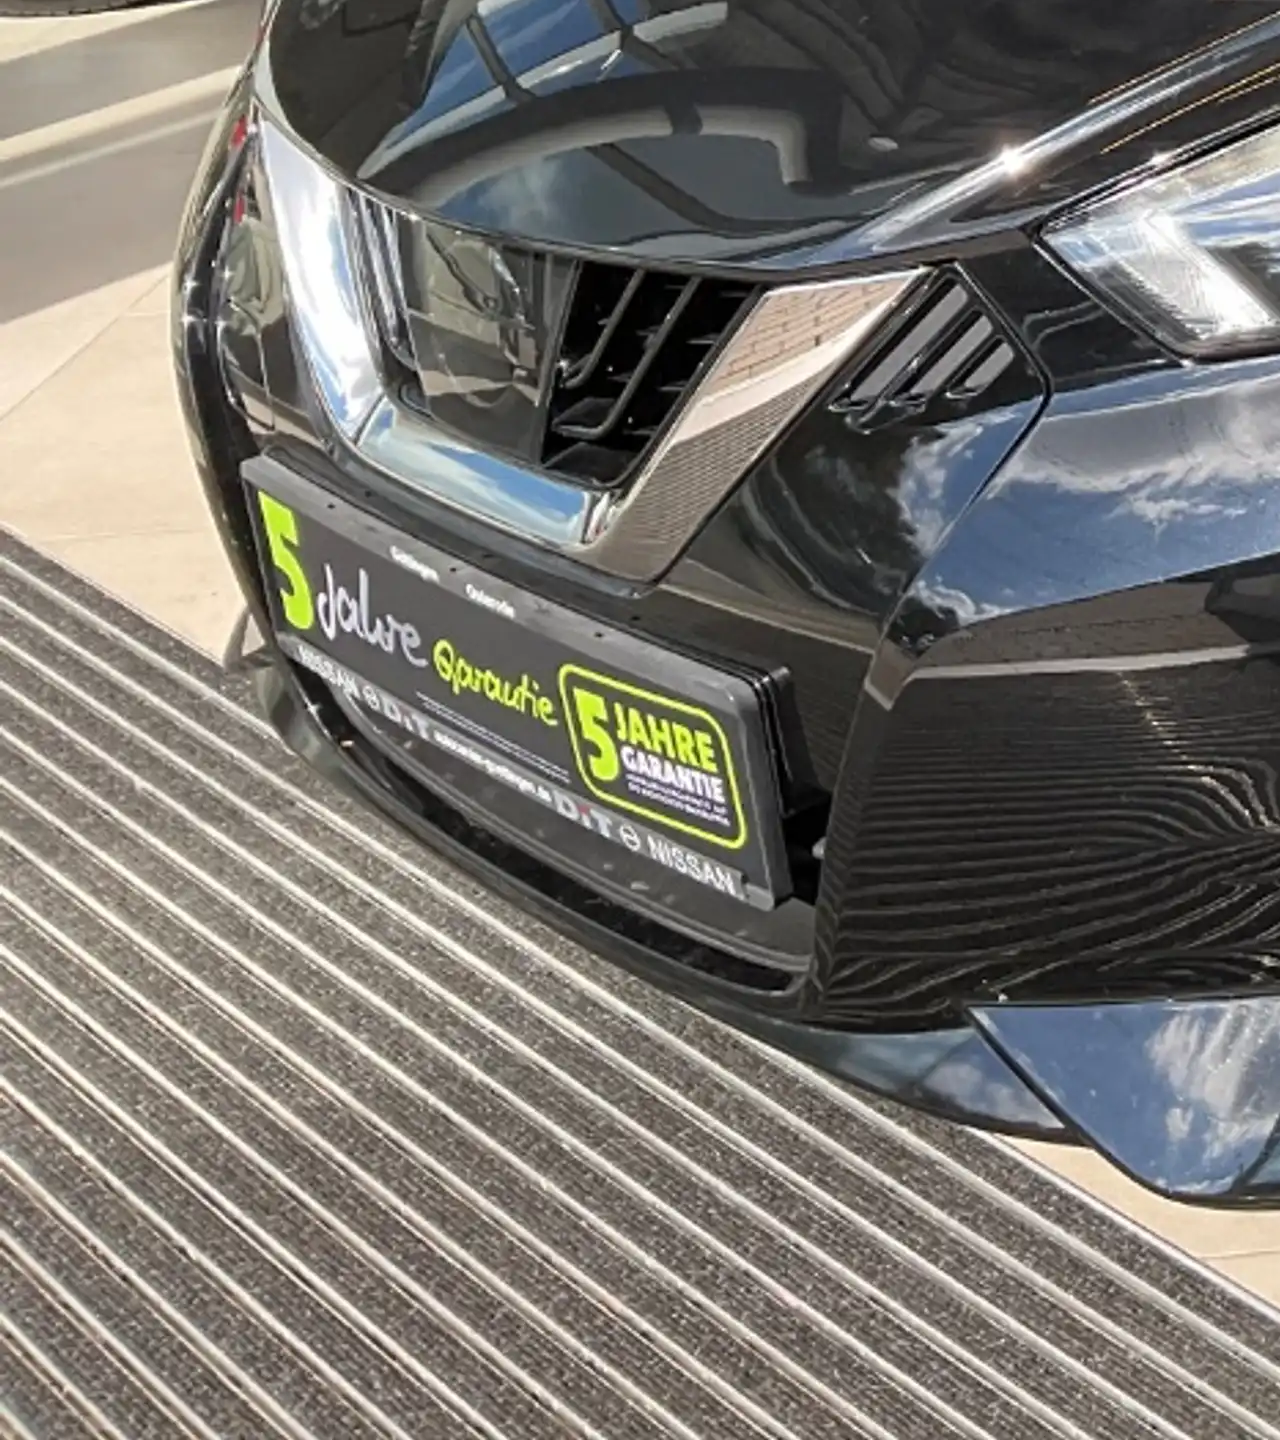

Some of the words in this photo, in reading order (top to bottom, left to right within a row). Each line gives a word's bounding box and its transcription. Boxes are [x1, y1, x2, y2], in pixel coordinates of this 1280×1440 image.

[257, 490, 314, 630] 5
[573, 687, 620, 782] 5
[614, 701, 719, 774] JAHRE
[620, 745, 726, 804] GARANTIE
[647, 834, 738, 897] NISSAN
